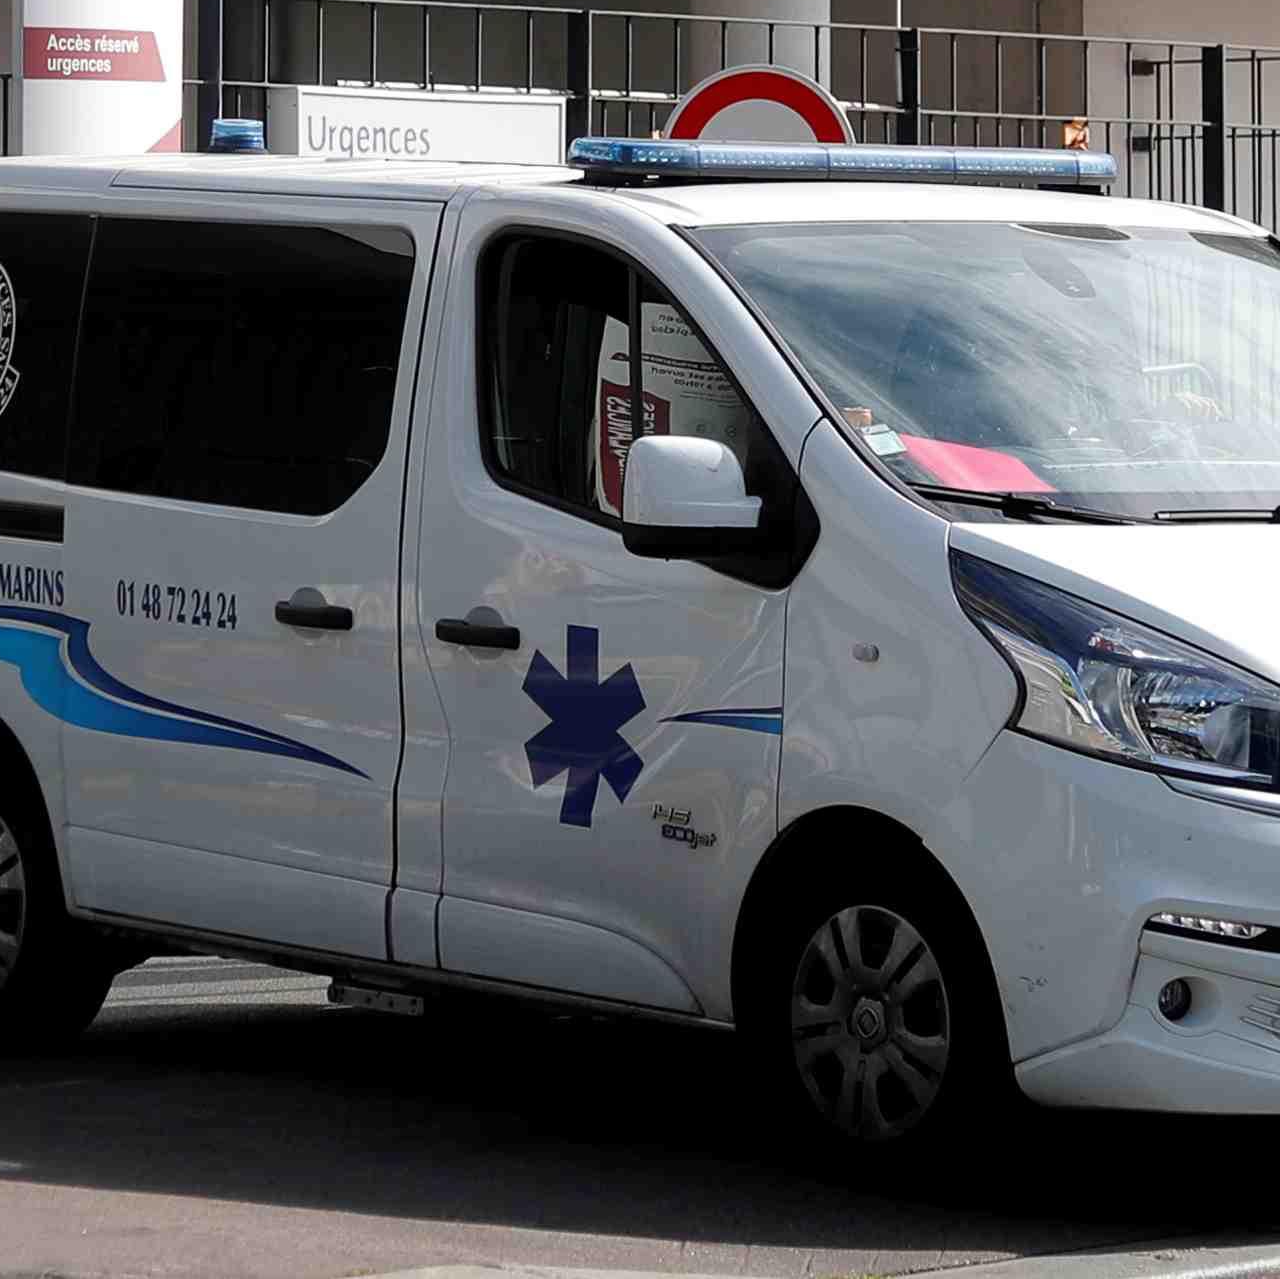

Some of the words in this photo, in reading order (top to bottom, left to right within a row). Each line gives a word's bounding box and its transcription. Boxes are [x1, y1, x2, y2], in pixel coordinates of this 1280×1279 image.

[47, 33, 92, 52] Accès
[94, 34, 139, 54] réservé
[47, 57, 112, 76] urgences
[307, 115, 431, 159] Urgences
[116, 579, 135, 616] 01
[142, 583, 161, 620] 48
[167, 586, 186, 623] 72
[191, 589, 211, 627] 24
[217, 592, 237, 630] 24
